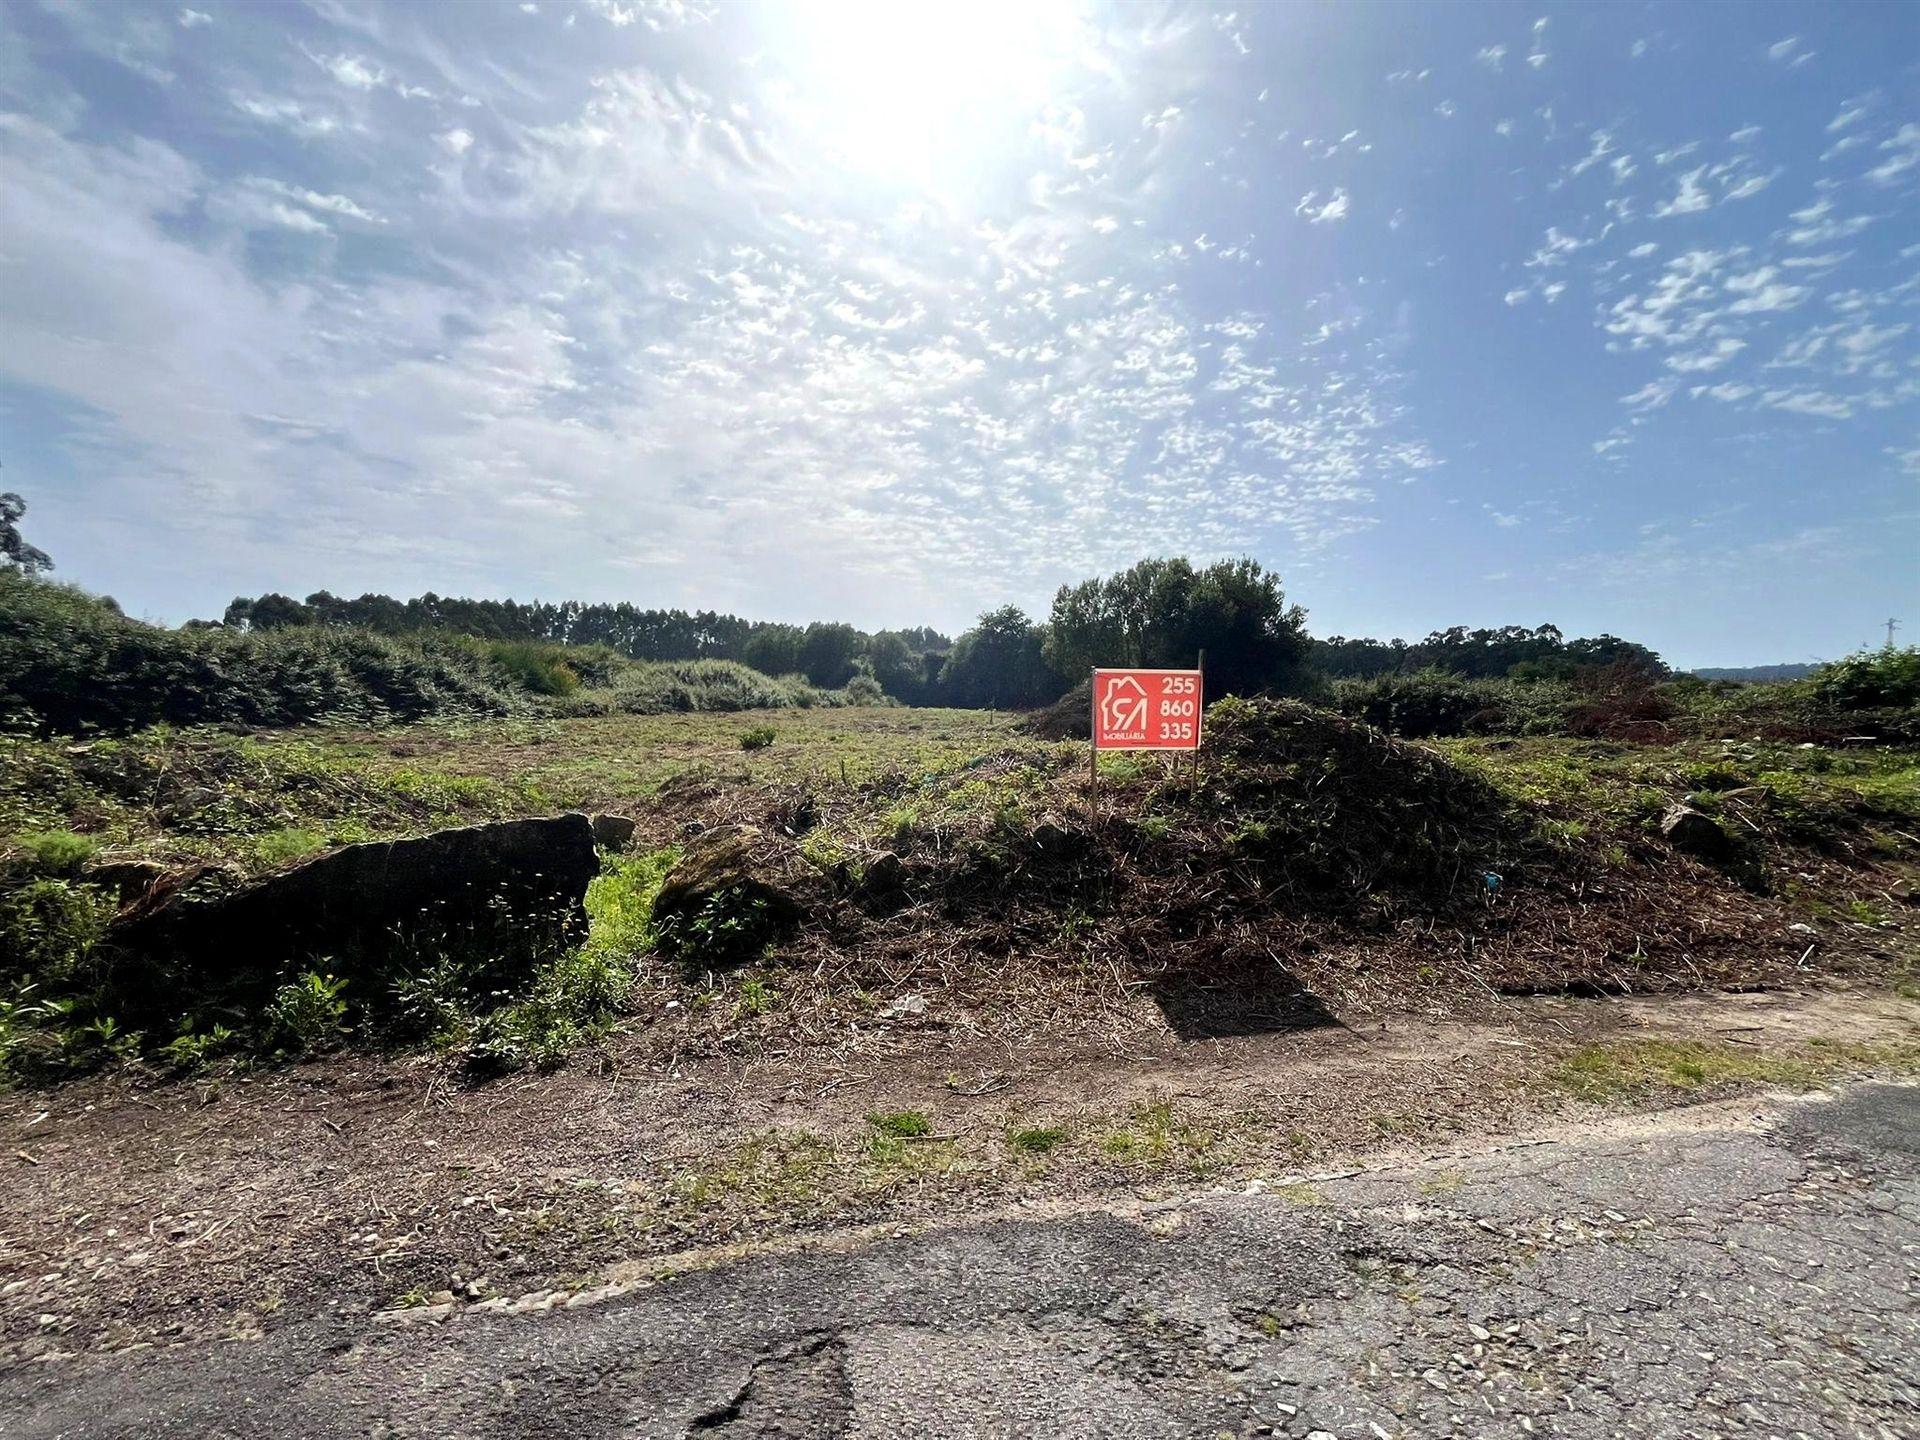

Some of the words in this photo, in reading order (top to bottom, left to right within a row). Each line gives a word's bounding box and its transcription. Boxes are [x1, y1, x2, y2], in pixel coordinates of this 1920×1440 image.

[1162, 677, 1195, 694] 255
[1160, 699, 1194, 717] 860
[1160, 722, 1192, 740] 335
